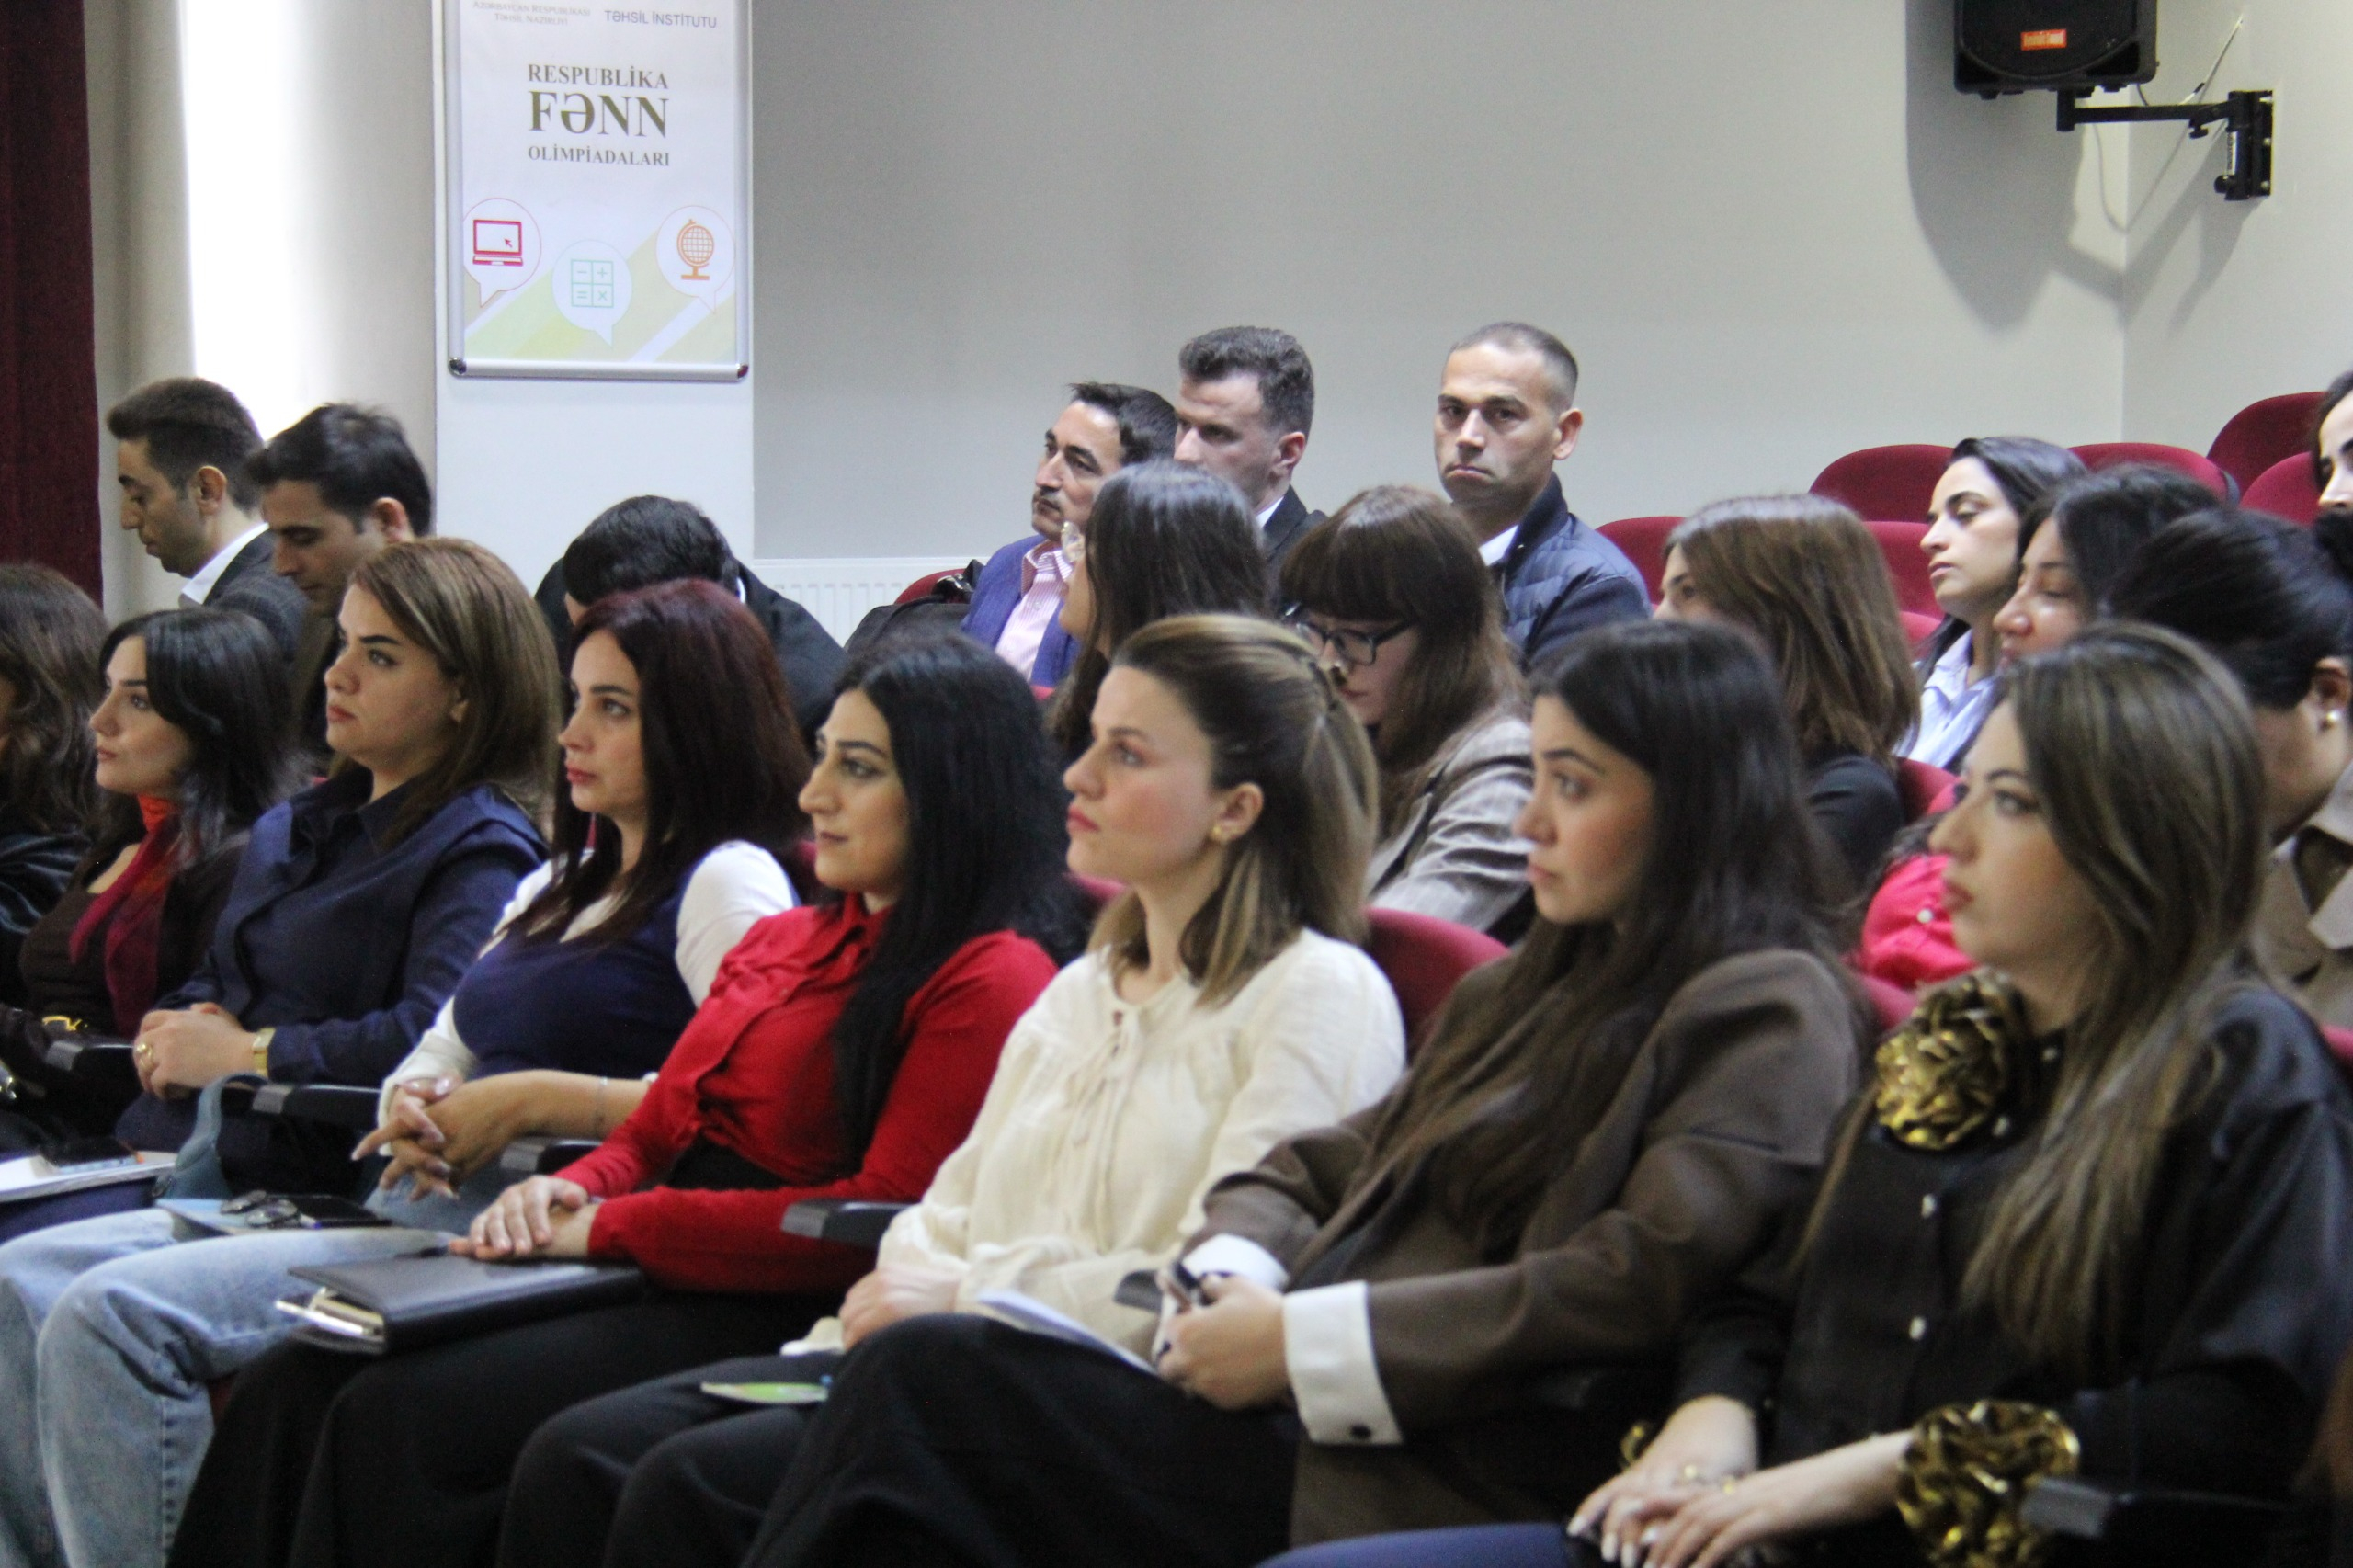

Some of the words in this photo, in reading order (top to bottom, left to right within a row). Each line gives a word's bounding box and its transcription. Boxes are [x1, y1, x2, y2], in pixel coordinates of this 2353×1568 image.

[604, 9, 649, 25] TƏHSİL
[652, 10, 717, 29] İNSTİTUTU
[528, 63, 669, 90] RESPUBLİKA
[528, 90, 669, 138] FƏNN
[528, 143, 669, 166] OLİMPİADALARI
